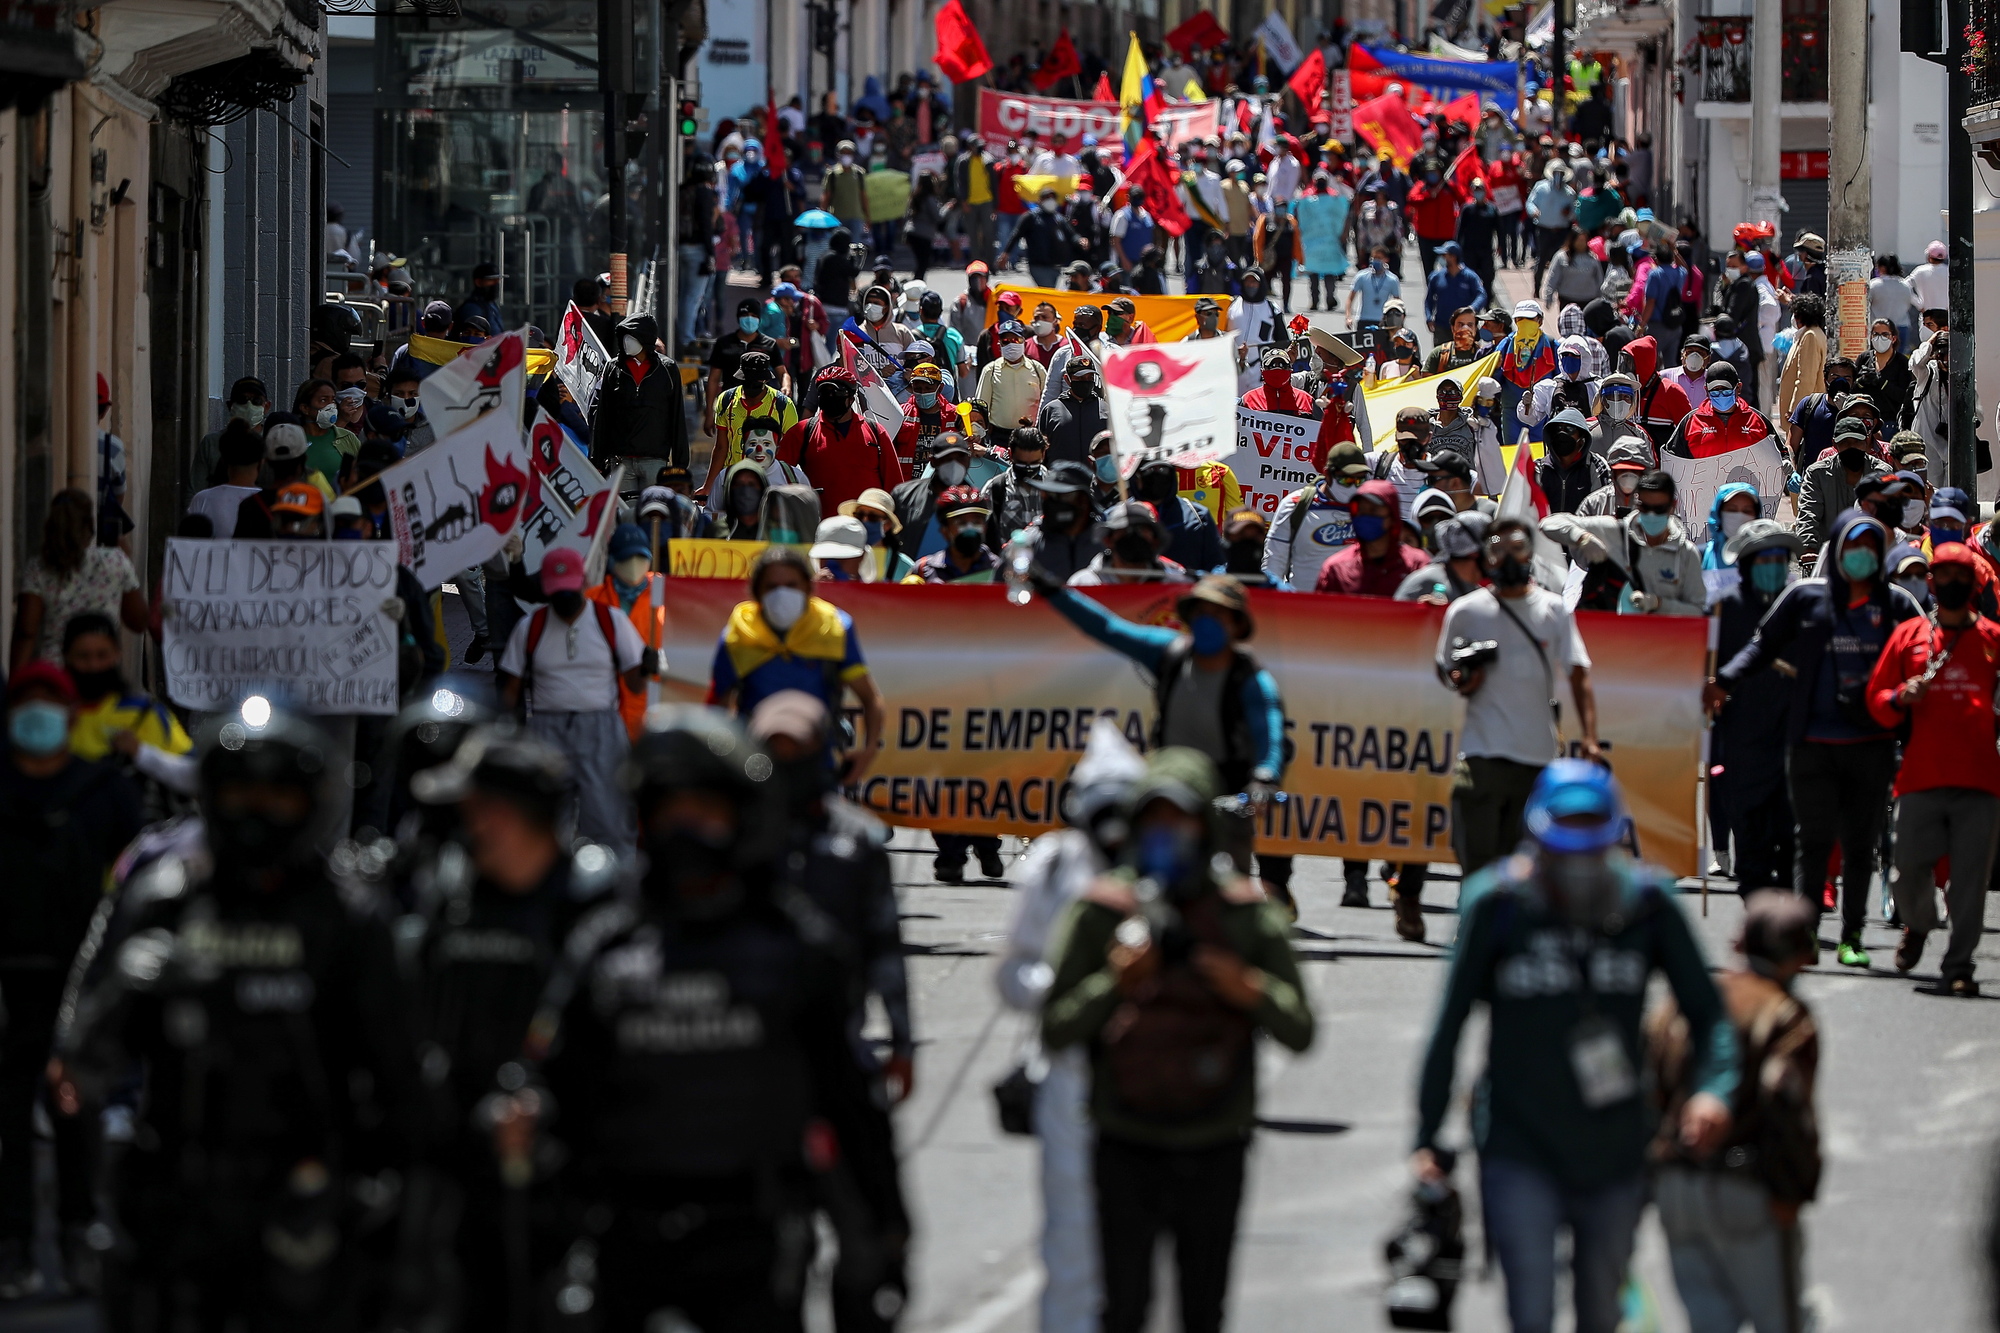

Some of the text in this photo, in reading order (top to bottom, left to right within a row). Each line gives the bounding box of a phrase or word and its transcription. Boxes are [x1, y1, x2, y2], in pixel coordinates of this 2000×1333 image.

[521, 47, 547, 61] DEL
[1351, 332, 1375, 349] La
[1252, 432, 1317, 462] Vid
[1260, 464, 1321, 484] Prime
[247, 544, 394, 594] DESPIDOS
[172, 596, 363, 636] TRABAJADORES
[898, 706, 952, 751] DE
[1358, 799, 1411, 848] DE
